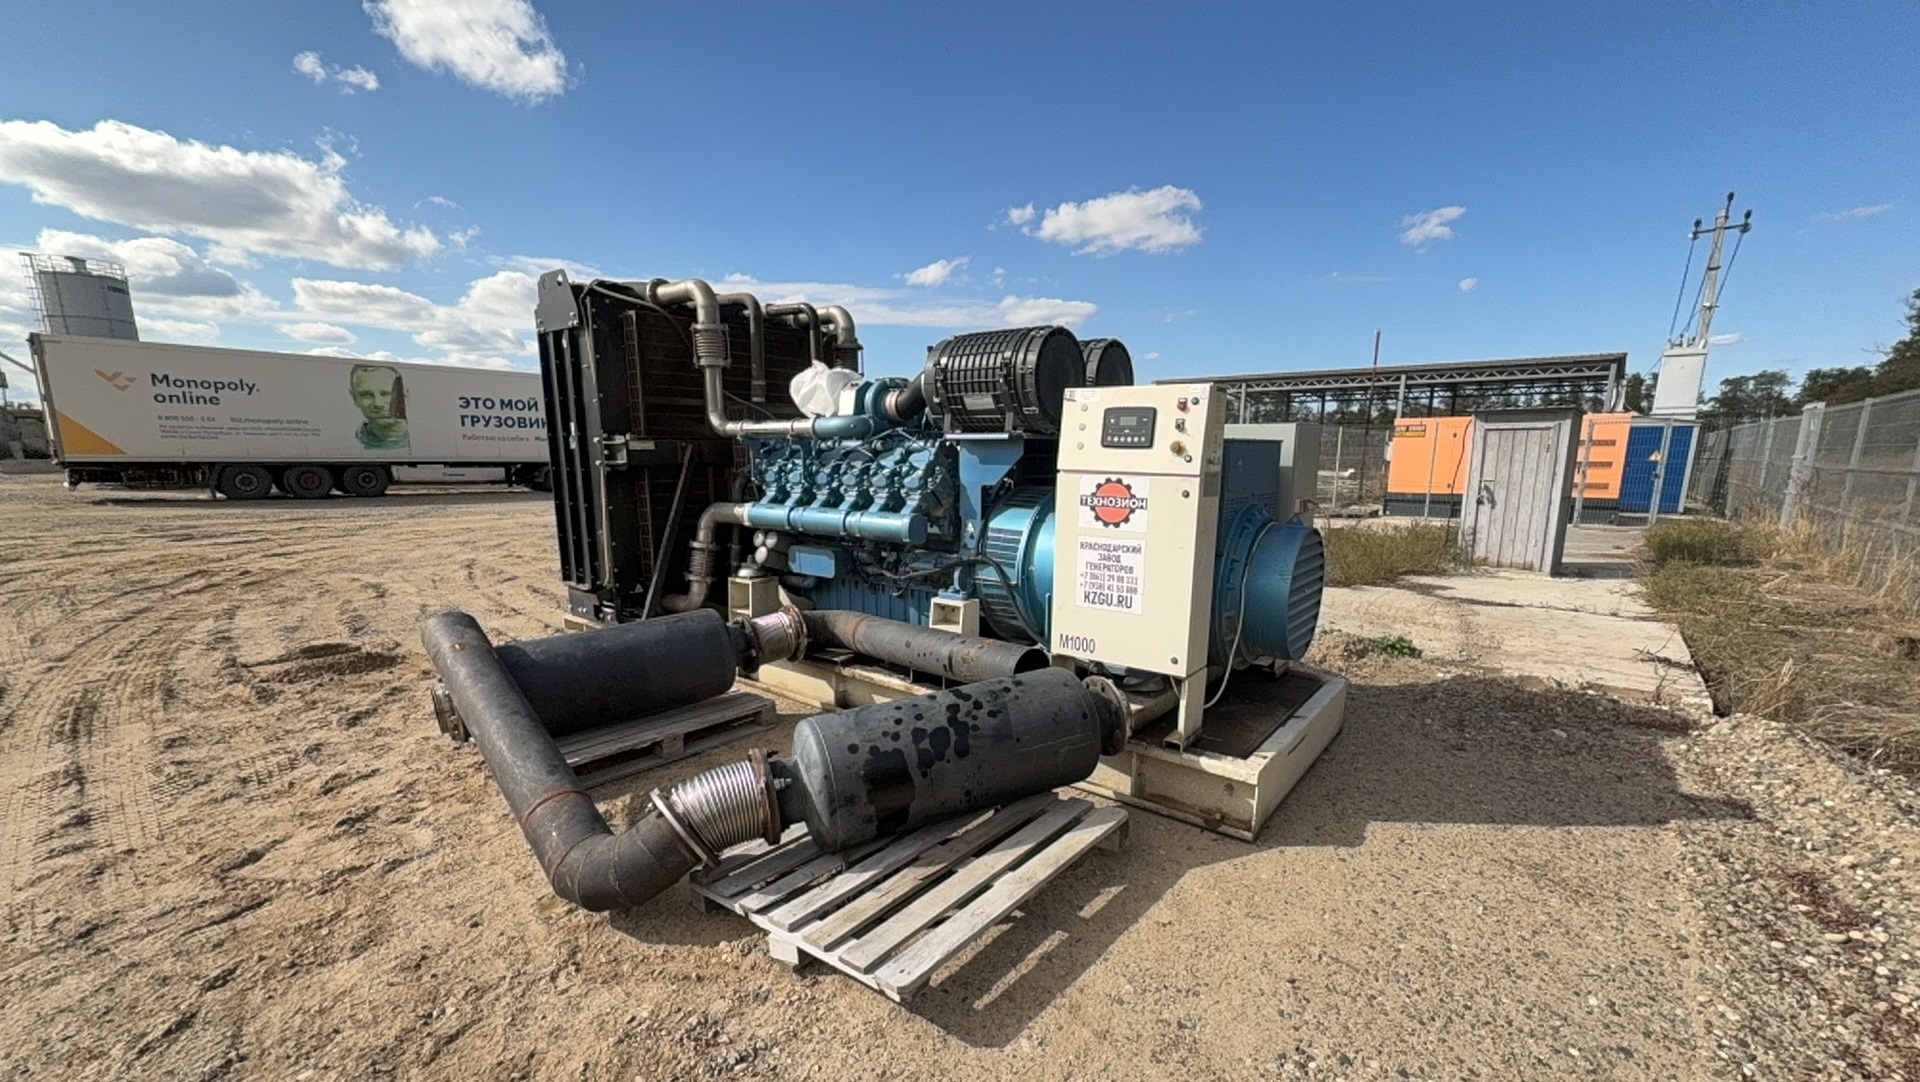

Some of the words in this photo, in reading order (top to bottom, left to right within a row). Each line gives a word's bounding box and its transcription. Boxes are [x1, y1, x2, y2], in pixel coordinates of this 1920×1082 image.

[150, 373, 260, 395] Monopoly.
[153, 391, 221, 405] online
[458, 397, 495, 410] ЭТО
[500, 397, 539, 412] МОЙ
[1081, 496, 1147, 509] ТЕХНОЗИОН
[1080, 541, 1142, 555] КРАСНОДАРСКИЙ
[1097, 552, 1122, 563] ЗАВОД
[1085, 561, 1134, 575] ГЕНЕРАТОРОВ
[1083, 590, 1133, 609] KZGU.RU
[1059, 633, 1096, 654] M1000
